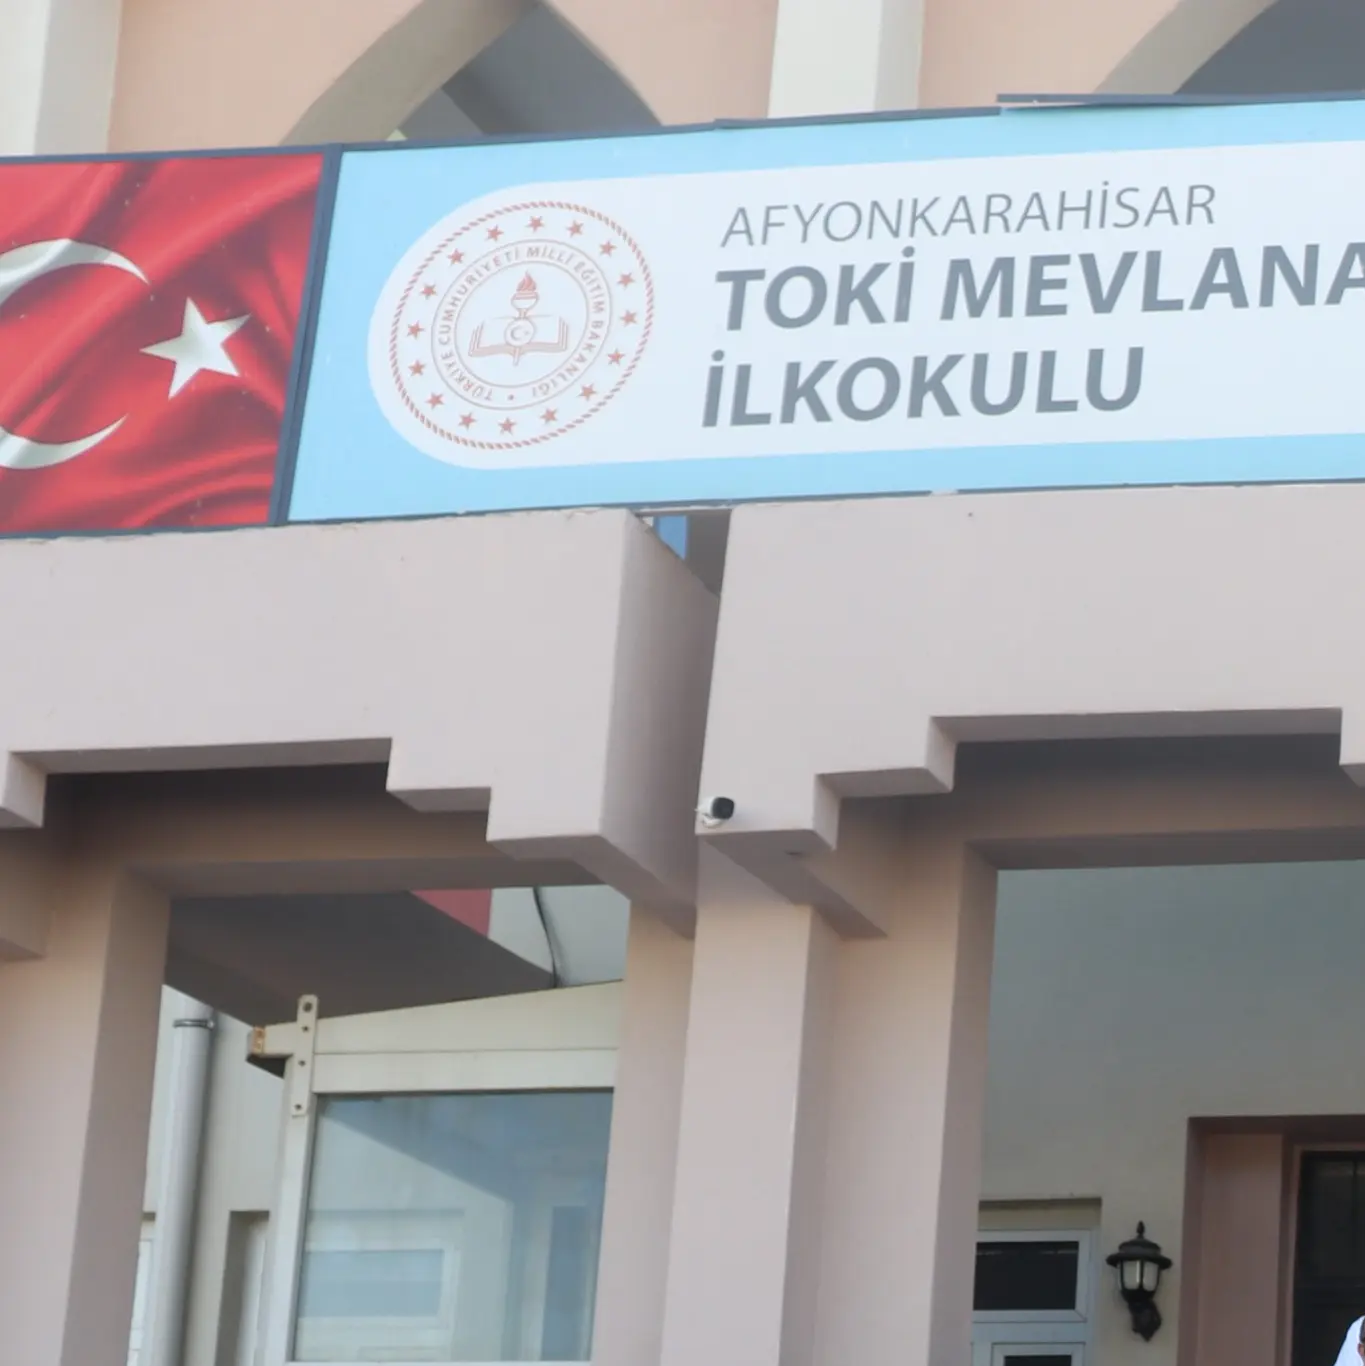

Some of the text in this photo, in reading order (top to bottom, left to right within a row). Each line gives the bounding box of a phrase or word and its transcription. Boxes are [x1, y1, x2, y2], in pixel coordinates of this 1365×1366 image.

[720, 180, 1216, 248] AFYONKARAHİSAR
[716, 246, 915, 331] TOKİ
[702, 346, 1145, 428] İLKOKULU
